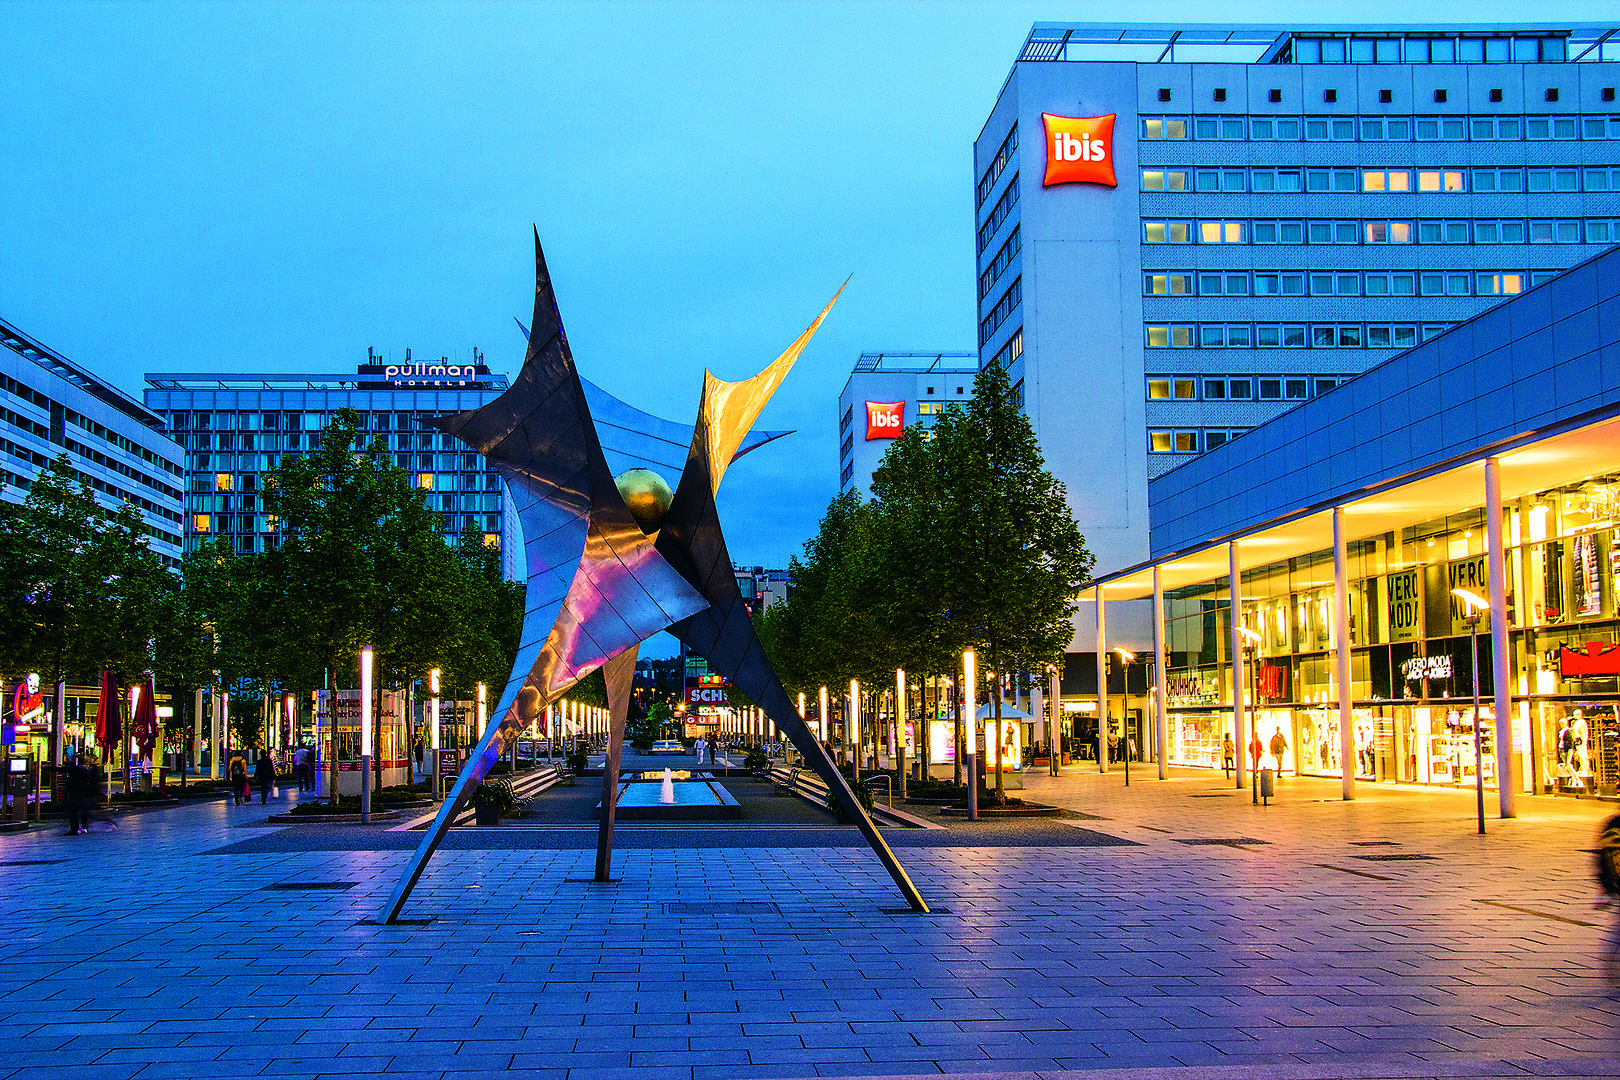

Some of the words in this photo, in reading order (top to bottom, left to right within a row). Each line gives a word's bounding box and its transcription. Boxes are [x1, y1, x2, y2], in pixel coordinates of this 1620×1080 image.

[1054, 132, 1106, 161] ibis
[385, 362, 476, 381] pullman
[871, 410, 900, 428] ibis
[1449, 559, 1485, 589] VERO
[1407, 657, 1427, 670] VERO
[1428, 655, 1452, 668] MODA
[1406, 668, 1423, 680] JACK
[1429, 666, 1452, 679] JONES
[1166, 677, 1197, 697] CHUHHOF
